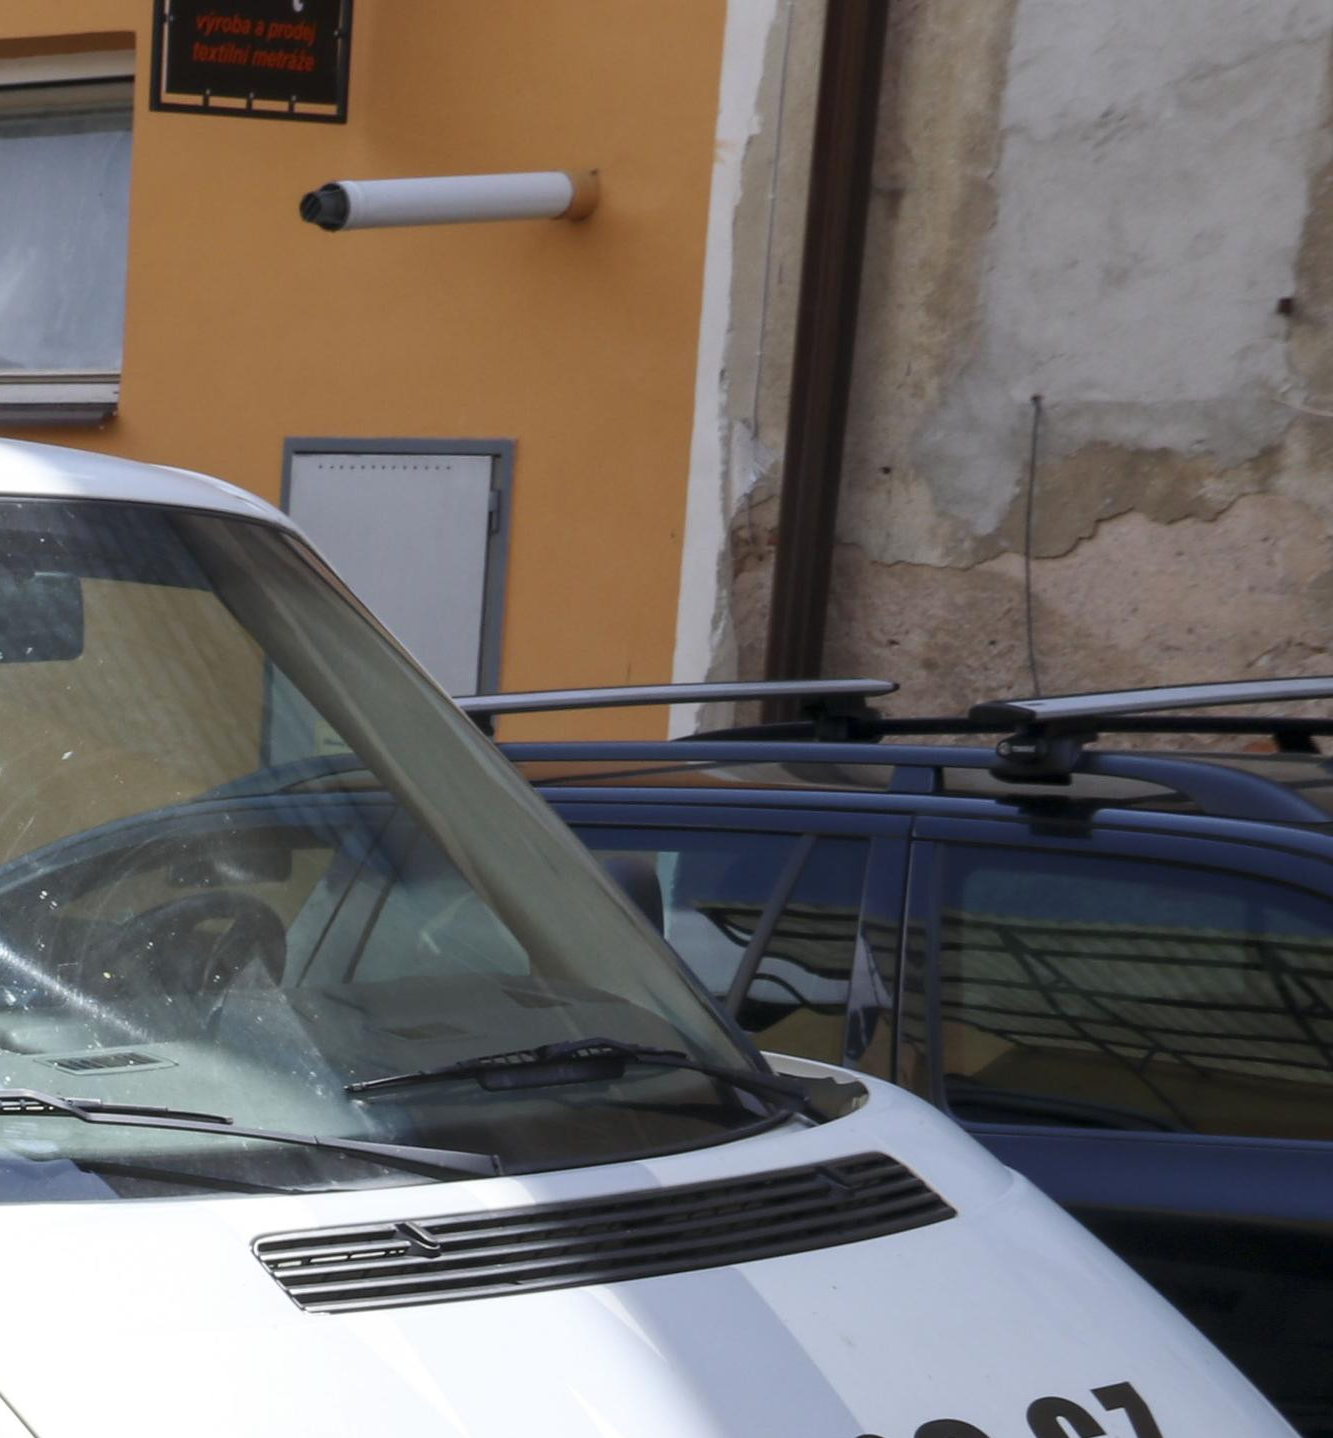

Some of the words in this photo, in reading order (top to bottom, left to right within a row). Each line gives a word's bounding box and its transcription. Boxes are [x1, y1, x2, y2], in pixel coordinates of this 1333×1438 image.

[196, 12, 252, 37] výroba
[254, 20, 264, 35] a
[267, 21, 316, 47] prodej
